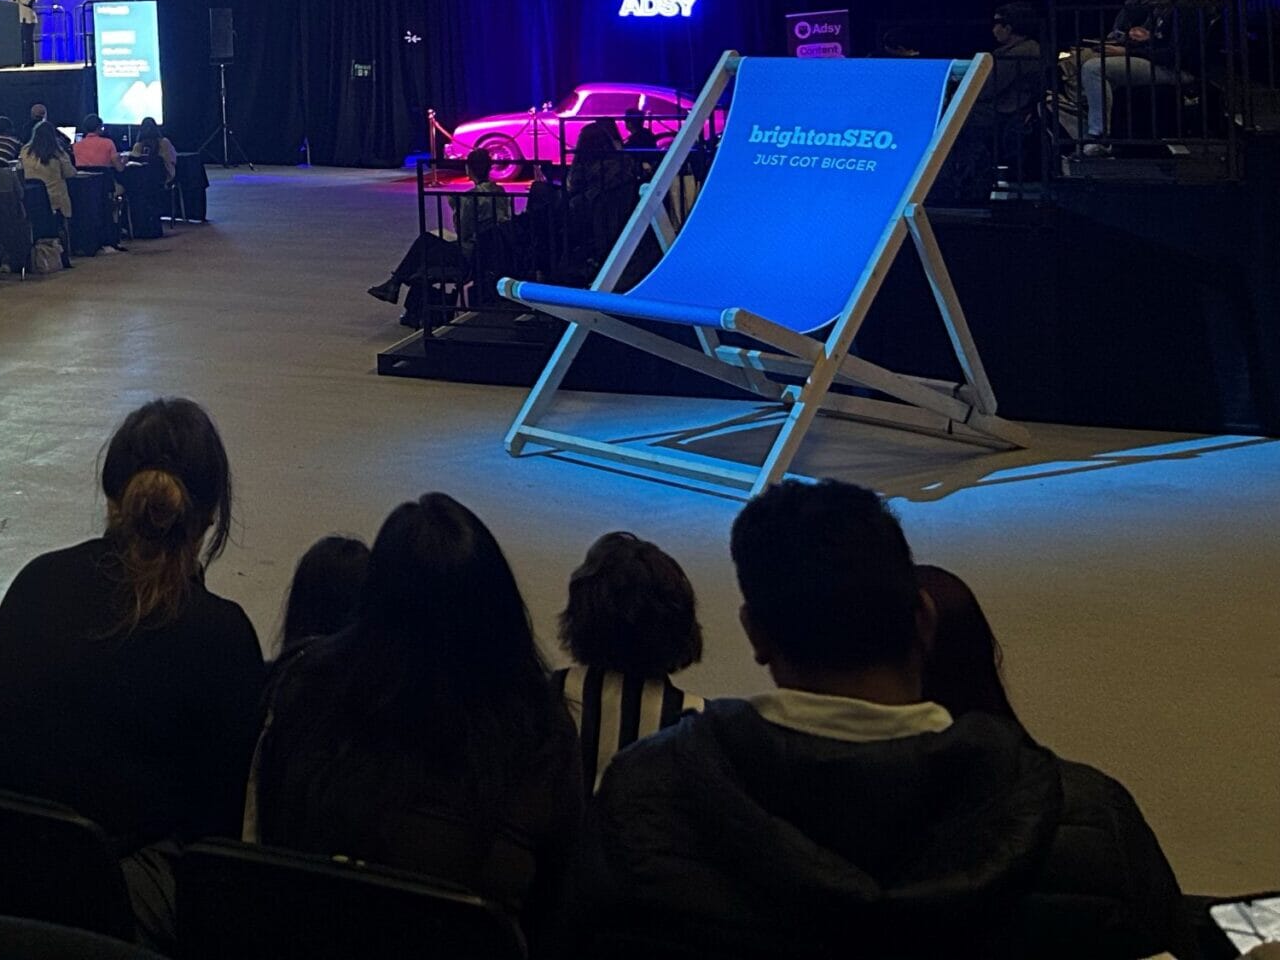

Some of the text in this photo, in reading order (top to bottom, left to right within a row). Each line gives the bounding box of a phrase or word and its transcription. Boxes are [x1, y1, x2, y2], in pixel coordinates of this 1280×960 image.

[812, 23, 841, 36] Adsy
[748, 124, 898, 150] brightonSEO.
[753, 154, 877, 171] JUST GOT BIGGER
